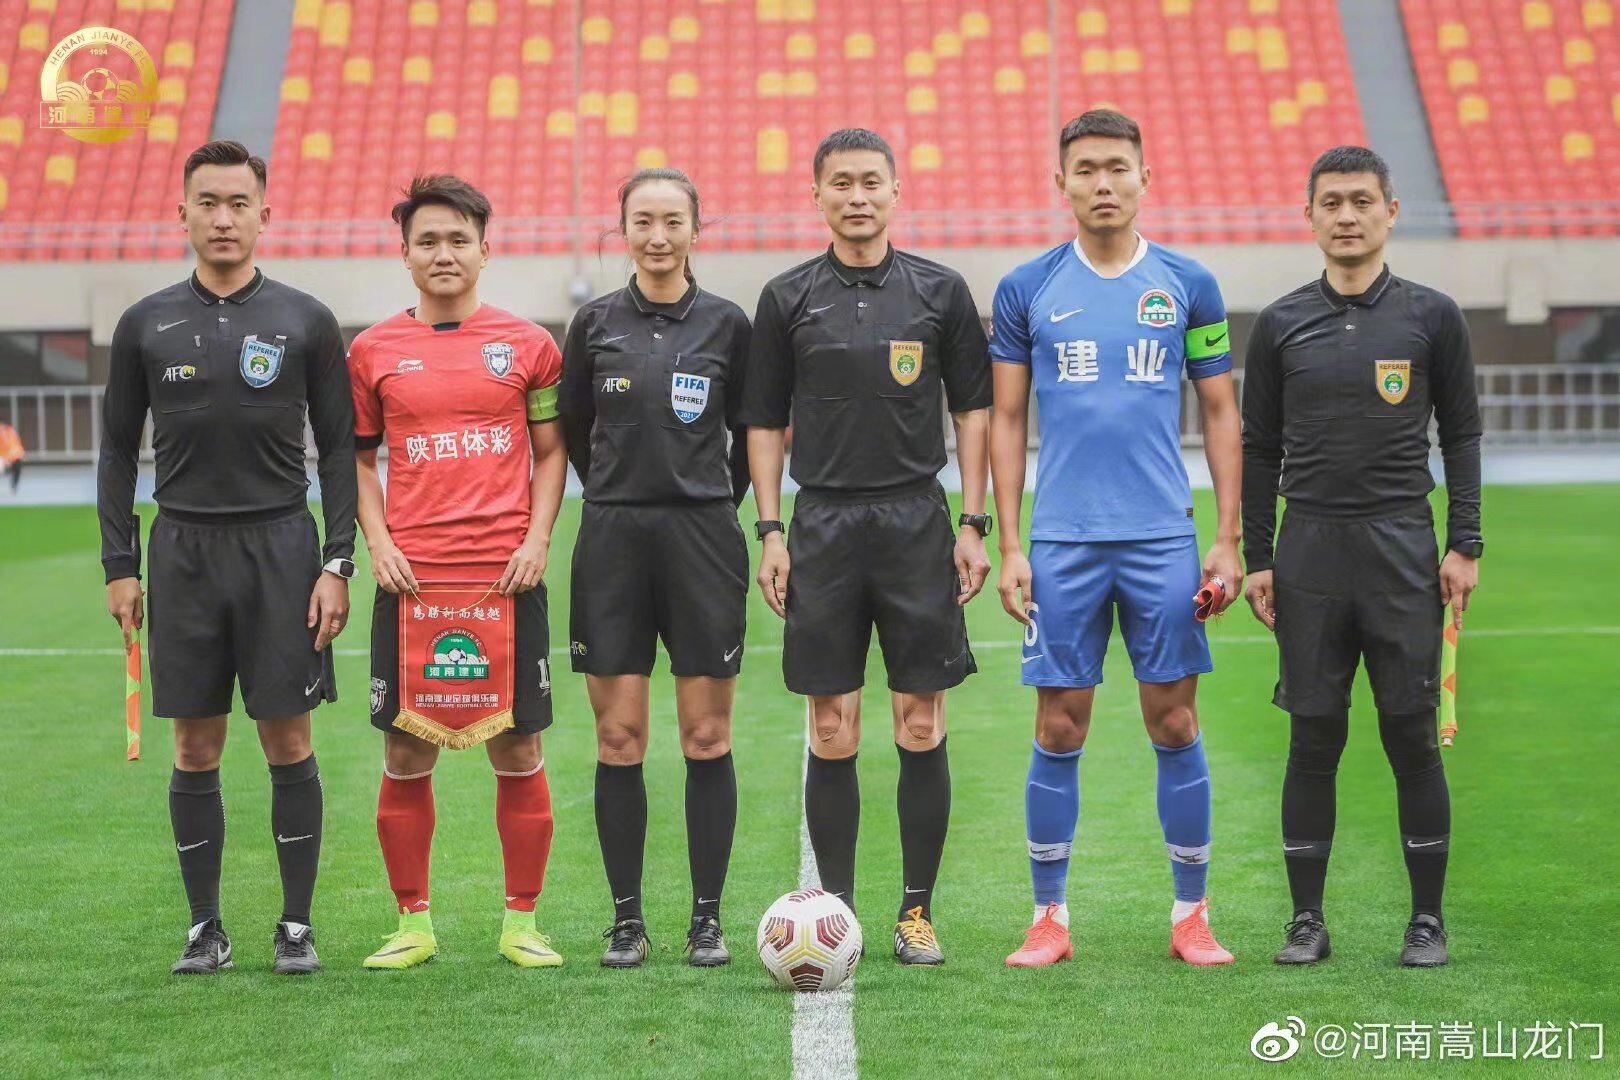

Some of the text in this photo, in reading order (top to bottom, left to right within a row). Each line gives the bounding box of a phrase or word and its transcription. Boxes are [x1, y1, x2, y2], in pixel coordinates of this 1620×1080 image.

[248, 344, 278, 357] REFEREE
[1054, 339, 1167, 382] 建业
[161, 365, 197, 382] AFC
[601, 377, 631, 393] AFC
[675, 376, 705, 391] FIFA
[674, 394, 704, 405] REFEREE
[680, 411, 694, 419] 2021
[405, 425, 513, 464] 陕西体彩
[430, 630, 449, 647] HENAN
[452, 629, 475, 639] JIANYE
[429, 666, 485, 677] 河南建业
